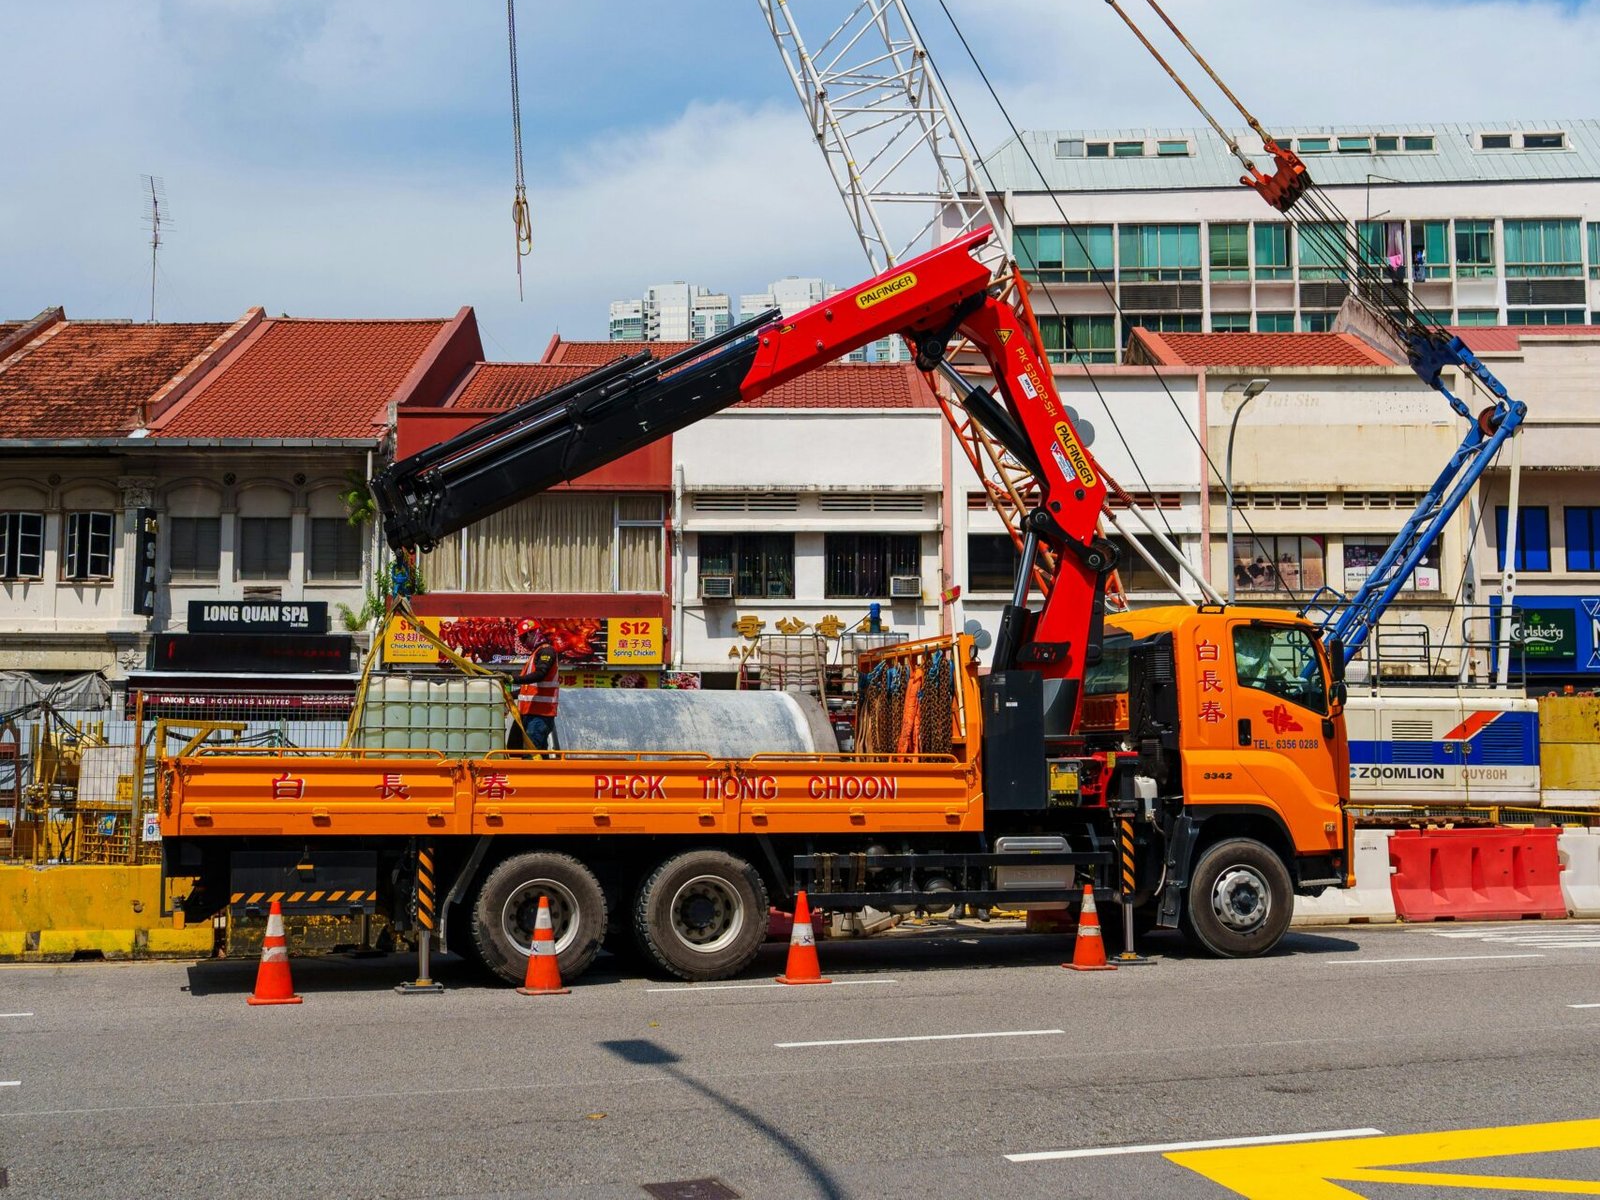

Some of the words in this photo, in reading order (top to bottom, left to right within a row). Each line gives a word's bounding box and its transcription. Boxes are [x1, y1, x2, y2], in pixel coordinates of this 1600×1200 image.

[859, 275, 914, 306] PALFINGER
[1015, 346, 1028, 363] PK
[1056, 424, 1094, 485] PALFINGER
[203, 605, 239, 622] LONG
[241, 605, 280, 624] QUAN
[281, 605, 309, 622] SPA
[620, 621, 650, 636] $12
[618, 638, 652, 649] 童子鸡
[613, 649, 632, 657] Spring
[1196, 639, 1227, 724] 白長春
[160, 696, 185, 704] UNION
[189, 696, 205, 705] GAS
[210, 697, 255, 705] HOLDINGS
[258, 698, 291, 706] LIMITED
[1253, 739, 1273, 750] TEL:
[1276, 739, 1297, 750] 6356
[1298, 739, 1319, 750] 0288
[1203, 772, 1233, 780] 3342
[1359, 767, 1445, 779] ZOOMLION
[594, 774, 667, 800] PECK
[697, 774, 779, 800] TIONG
[807, 775, 899, 800] CHOON
